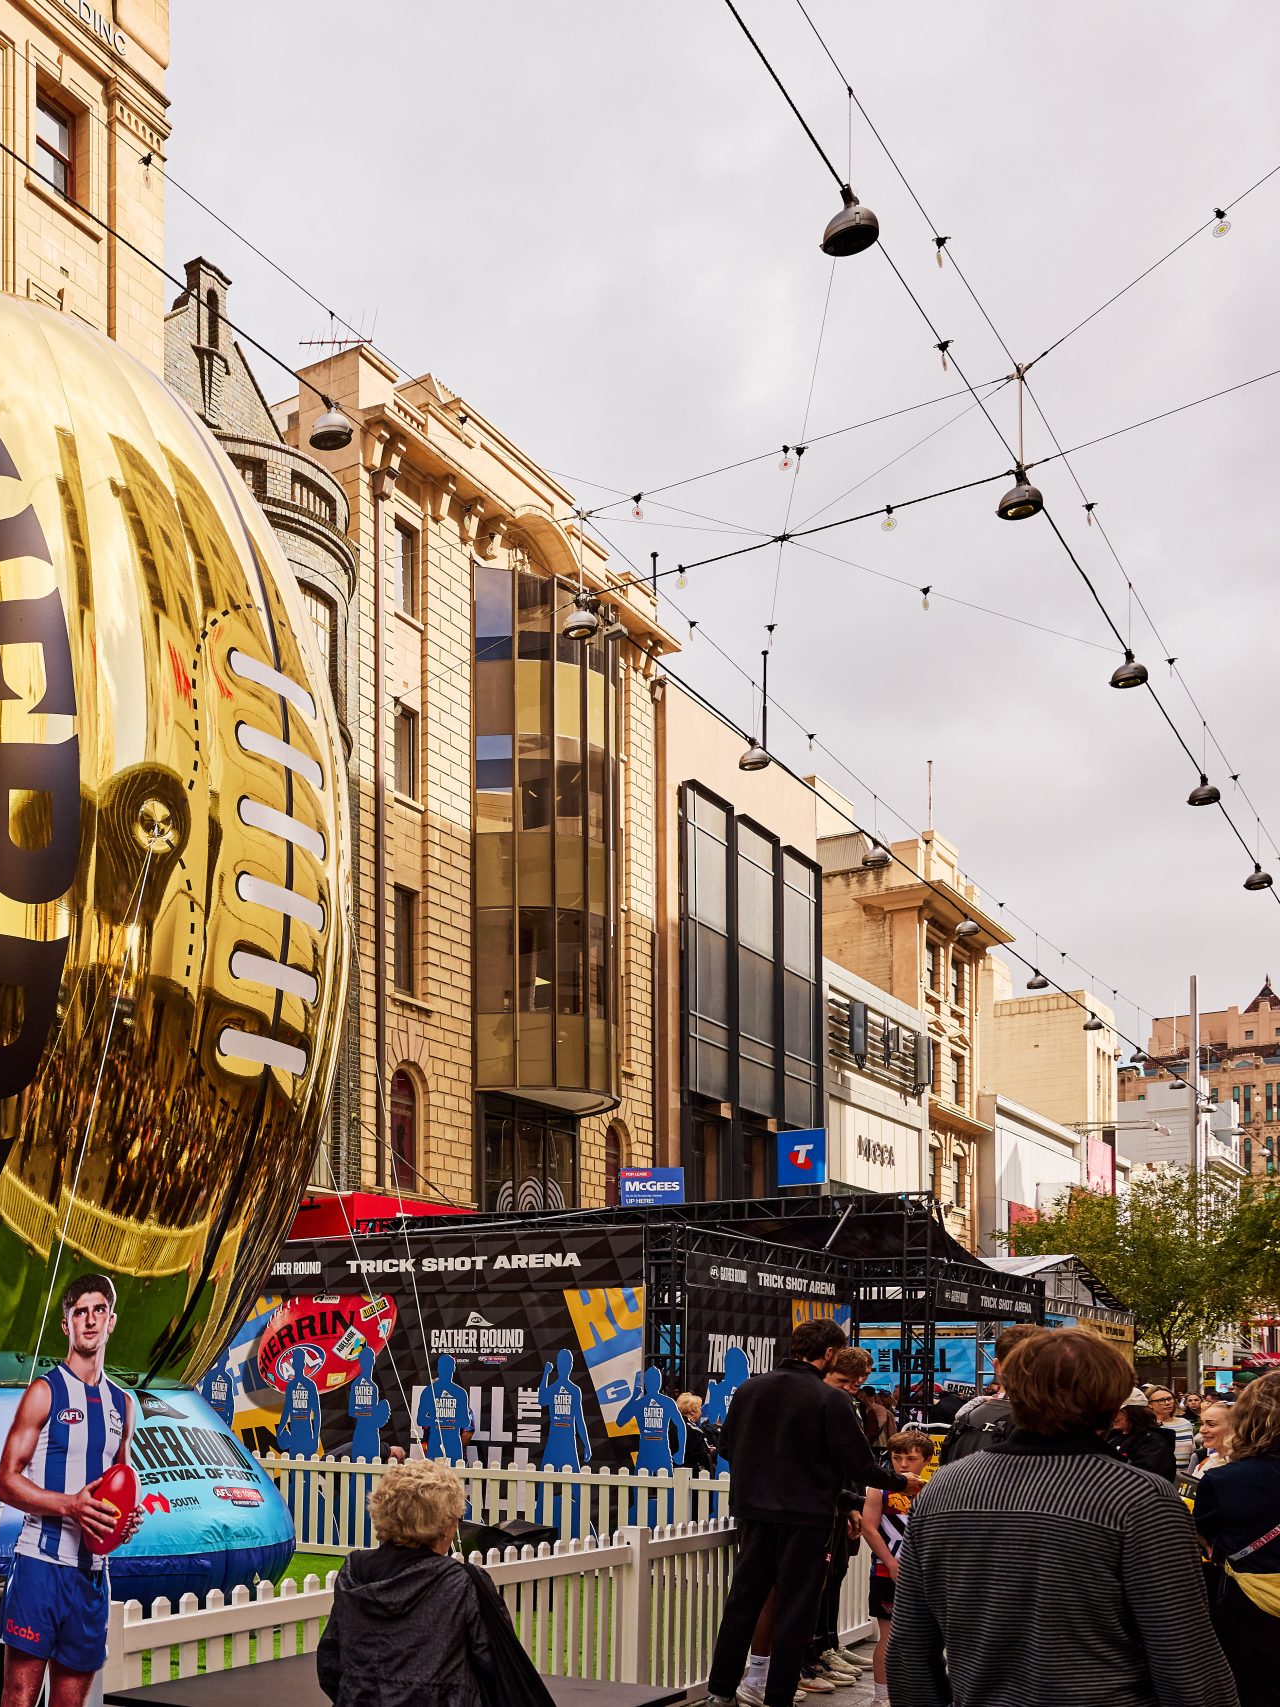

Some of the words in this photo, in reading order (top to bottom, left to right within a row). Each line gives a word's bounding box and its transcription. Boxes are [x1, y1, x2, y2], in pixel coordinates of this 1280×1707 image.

[625, 1180, 680, 1192] McGEES
[271, 1262, 292, 1276] THER
[293, 1261, 321, 1275] ROUND
[346, 1258, 416, 1274] TRICK
[421, 1256, 487, 1271] SHOT
[492, 1252, 582, 1270] ARENA
[757, 1272, 784, 1288] TRICK
[785, 1278, 808, 1293] SHOT
[808, 1281, 836, 1296] ARENA
[980, 1295, 997, 1309] TRICK
[998, 1298, 1014, 1311] SHOT
[1014, 1301, 1032, 1314] ARENA
[260, 1310, 356, 1377] SHERRIN
[336, 1330, 357, 1353] ADELAIDE
[430, 1329, 478, 1348] GATHER
[479, 1329, 524, 1348] ROUND
[746, 1336, 776, 1374] SHOT
[878, 1349, 891, 1363] THE
[292, 1389, 308, 1400] GATHER
[354, 1386, 373, 1396] GATHER
[948, 1383, 976, 1396] BAROS
[434, 1398, 457, 1408] GATHER
[517, 1387, 542, 1419] THE
[554, 1394, 572, 1405] GATHER
[59, 1411, 84, 1422] AFL
[435, 1408, 456, 1418] ROUND
[644, 1407, 664, 1418] GATHER
[644, 1417, 663, 1429] ROUND
[517, 1424, 542, 1443] IN
[130, 1426, 195, 1471] HER
[177, 1426, 253, 1471] ROUND
[139, 1468, 205, 1486] ESTIVAL
[205, 1467, 224, 1479] OF
[223, 1469, 262, 1485] FOOTY
[215, 1488, 232, 1498] AFL
[169, 1496, 200, 1508] SOUTH
